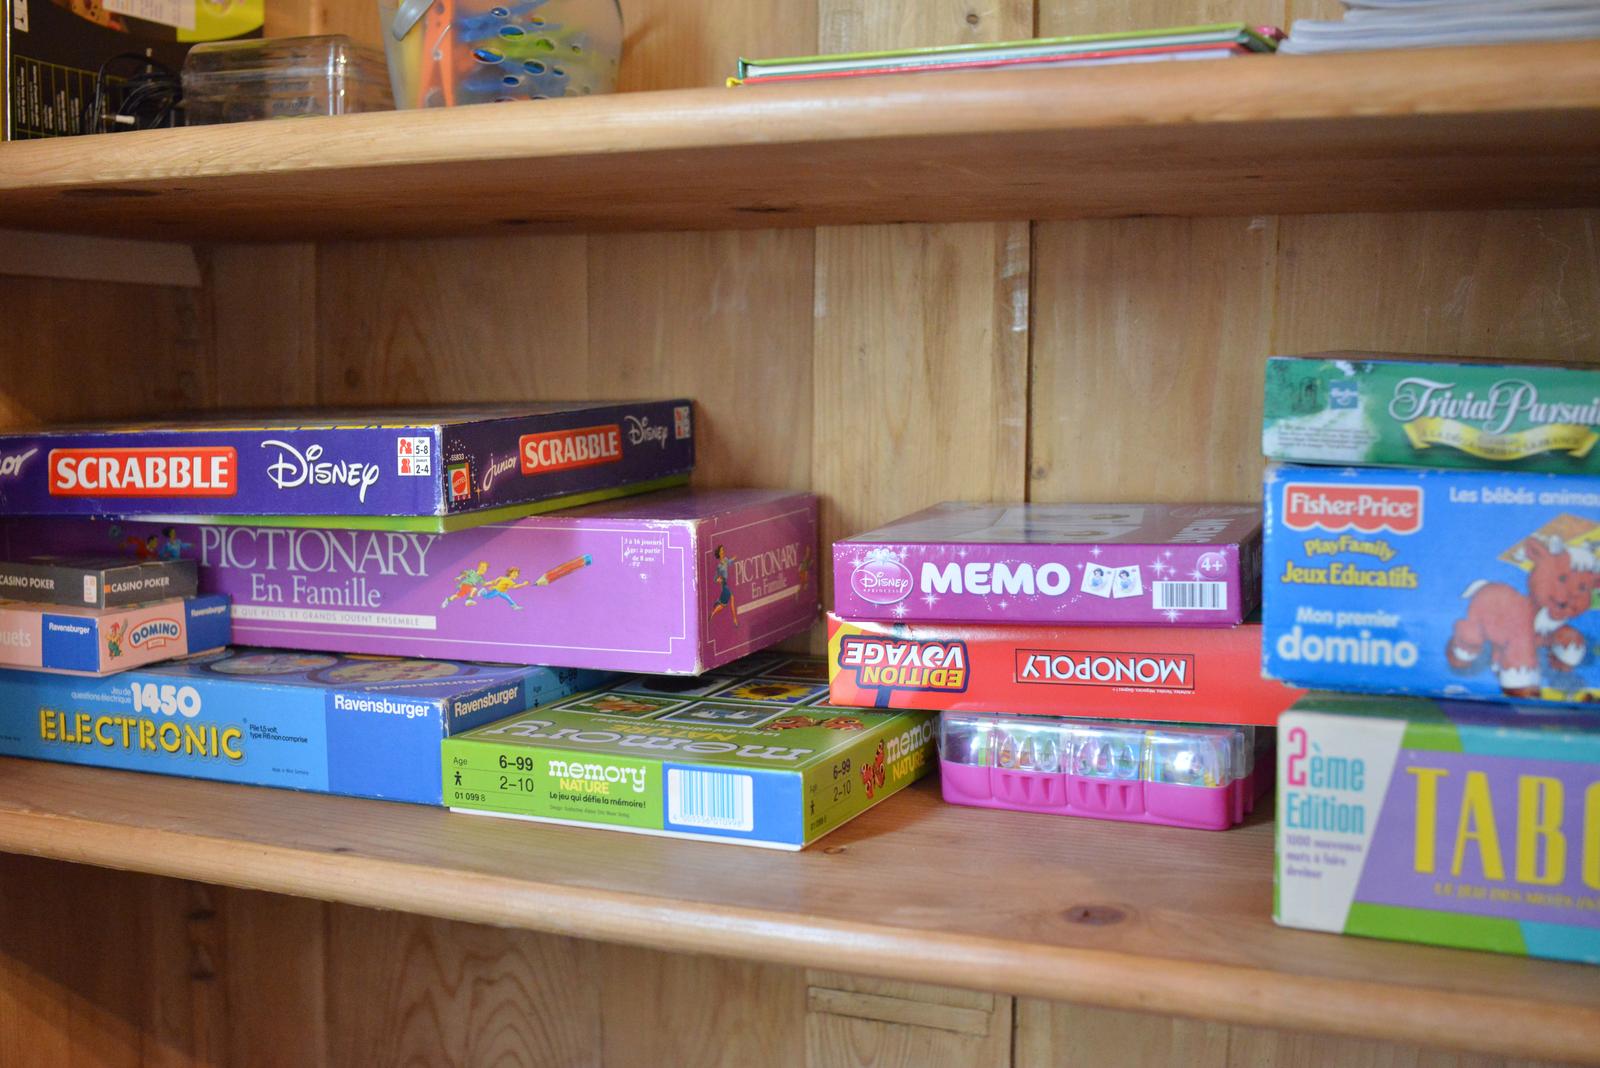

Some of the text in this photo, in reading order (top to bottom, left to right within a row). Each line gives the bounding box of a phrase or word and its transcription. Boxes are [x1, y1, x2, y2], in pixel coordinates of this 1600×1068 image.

[1389, 377, 1495, 422] Trivial
[416, 445, 428, 455] 5-8
[525, 431, 618, 468] SCRABBLE
[624, 415, 668, 448] Disney
[0, 440, 379, 503] or SCRABBLE Disney
[416, 464, 429, 474] 2-4
[1291, 492, 1415, 518] Fisher-Price
[1449, 487, 1478, 503] Les
[1482, 486, 1533, 505] bébés
[200, 526, 435, 577] PICTIONARY
[735, 543, 799, 585] PICTIONARY
[1201, 558, 1223, 571] 4+
[29, 577, 55, 590] POKER
[111, 576, 170, 593] CASINO POKER
[856, 569, 908, 593] Disney
[920, 562, 1071, 595] MEMO
[1281, 560, 1418, 589] Jeux Educatifs
[251, 573, 382, 608] En Famille
[191, 605, 227, 618] Ravensburger
[376, 616, 420, 627] ENSEMBLE
[1297, 607, 1399, 629] Mon premier
[0, 622, 90, 648] uets Ravensburger
[132, 623, 178, 644] DOMINO
[1277, 626, 1418, 667] domino
[845, 642, 963, 668] VOYAGE
[863, 666, 962, 686] EDITION
[1022, 654, 1186, 684] MONOPOLY
[131, 682, 201, 718] 1450
[334, 694, 430, 720] Ravensburger
[454, 685, 519, 718] Ravensburger
[39, 710, 243, 759] ELECTRONIC
[486, 719, 814, 761] memory
[453, 755, 533, 771] Age 6-99
[1287, 726, 1365, 791] 2ème
[500, 776, 534, 792] 2-10
[549, 760, 646, 792] memory
[560, 777, 610, 794] NATURE
[549, 791, 558, 799] Le
[558, 792, 569, 802] jeu
[570, 794, 582, 803] qui
[602, 796, 609, 804] la
[1285, 792, 1365, 835] Edition
